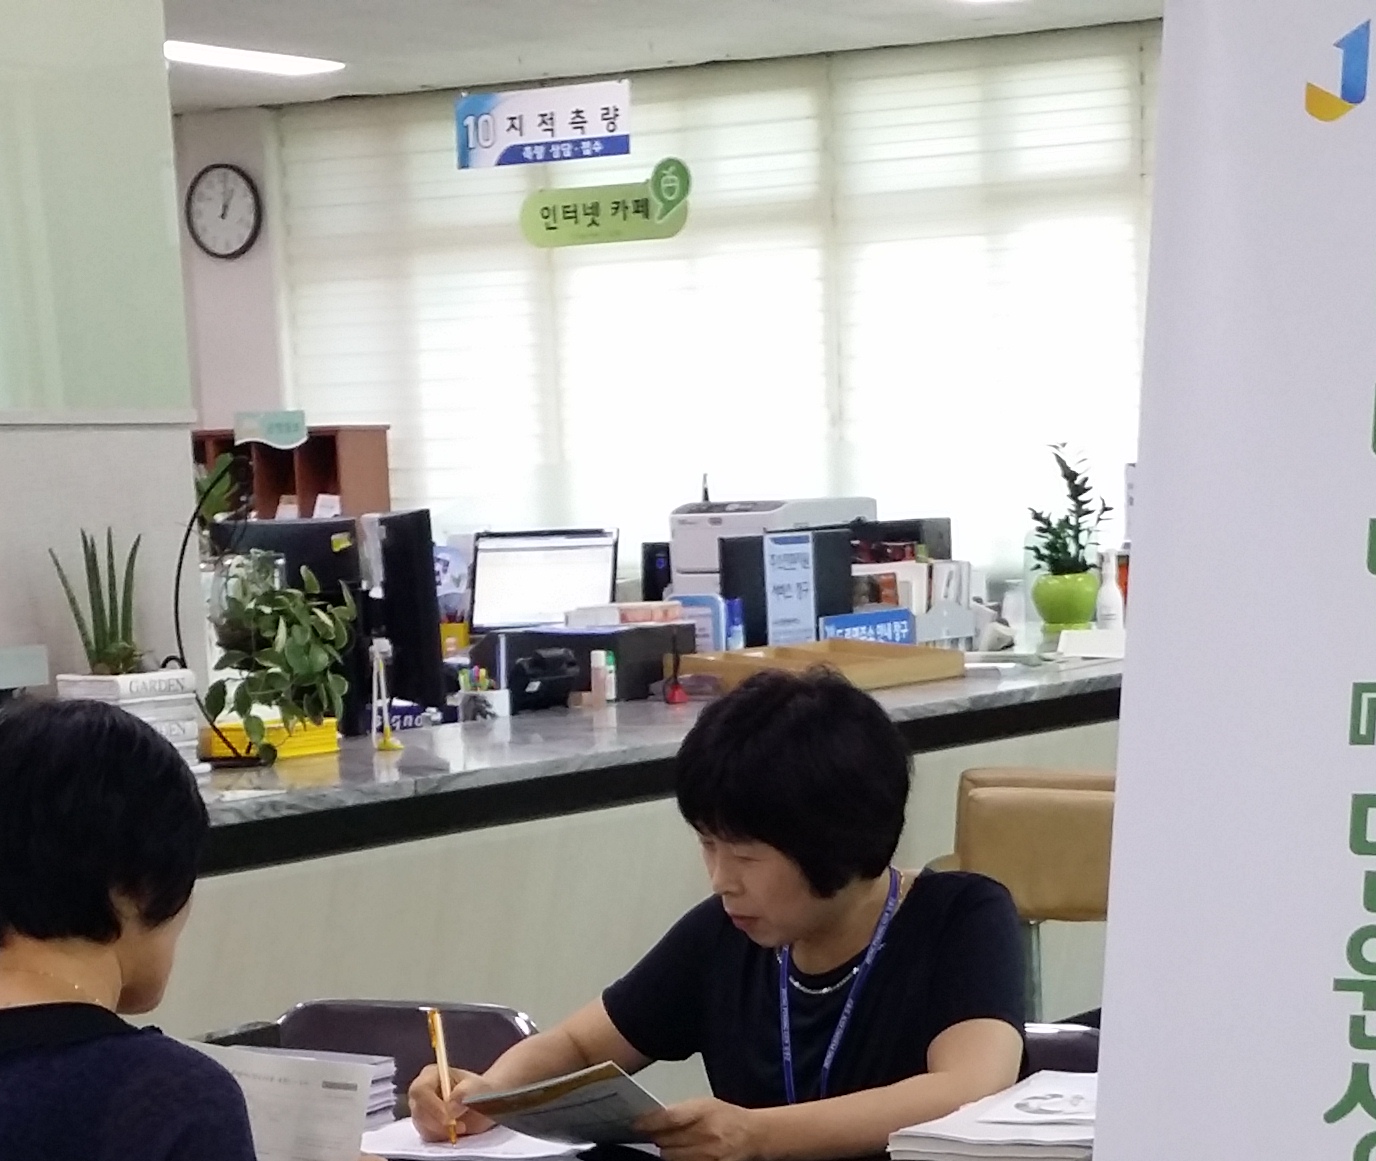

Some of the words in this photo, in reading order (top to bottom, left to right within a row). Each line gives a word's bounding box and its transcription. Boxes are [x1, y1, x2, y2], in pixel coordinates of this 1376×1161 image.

[462, 112, 495, 150] 10
[539, 201, 601, 231] 인터넷
[610, 197, 650, 222] 카페
[129, 677, 186, 694] GARDEN
